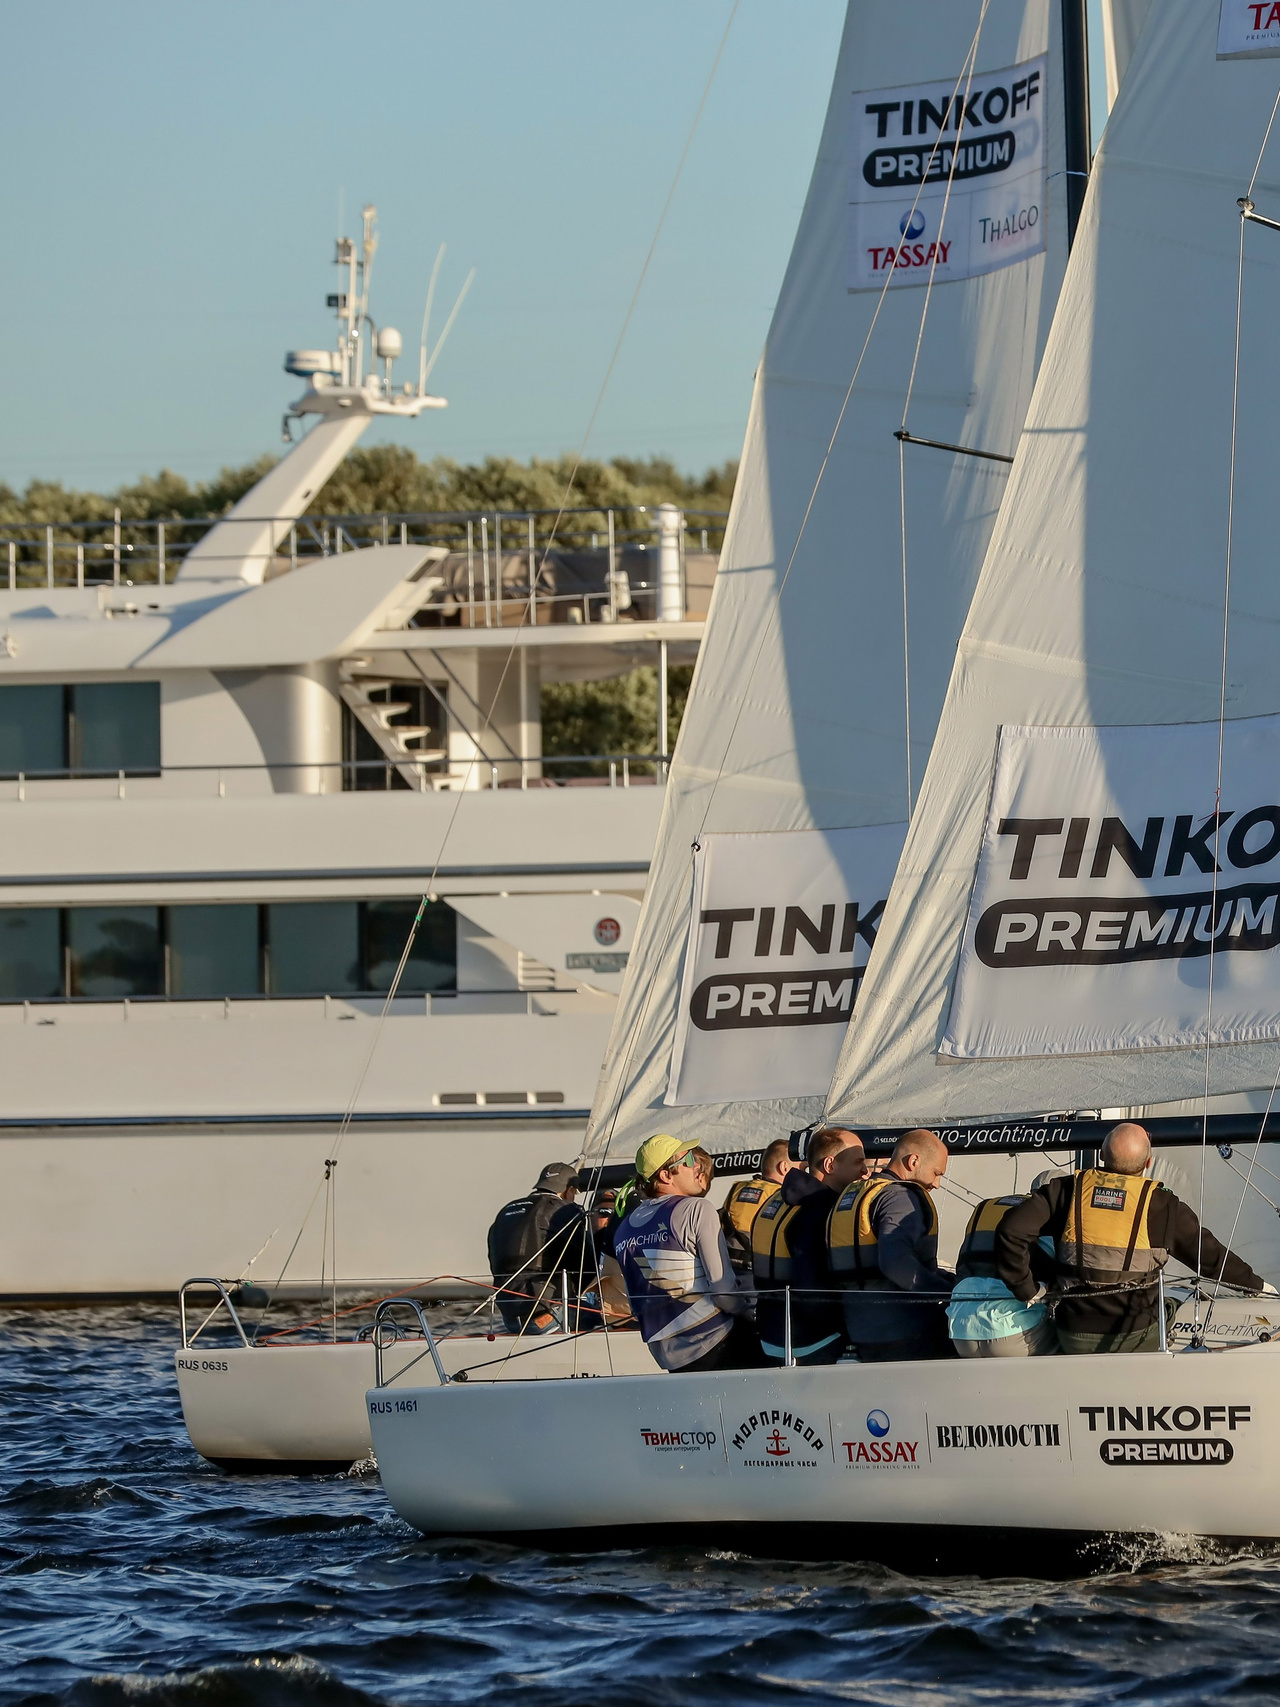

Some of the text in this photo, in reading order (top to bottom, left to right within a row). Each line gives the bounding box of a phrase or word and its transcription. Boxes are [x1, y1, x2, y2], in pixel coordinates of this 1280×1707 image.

[865, 70, 1040, 138] TINKOFF
[874, 138, 1009, 180] PREMIUM
[867, 241, 952, 270] TASSAY
[993, 894, 1279, 954] PREMIUM
[1095, 1189, 1124, 1197] MARINE
[178, 1359, 229, 1371] RUS 0635
[370, 1400, 418, 1415] RUS 1461
[1079, 1405, 1252, 1431] TINKOFF
[732, 1410, 824, 1451] МОРПРИБОР
[936, 1423, 1061, 1450] ВЕДОМОСТИ
[743, 1460, 795, 1468] ЛЕГЕНДАРНЫЕ
[841, 1441, 919, 1463] TASSAY
[1107, 1443, 1225, 1461] PREMIUM
